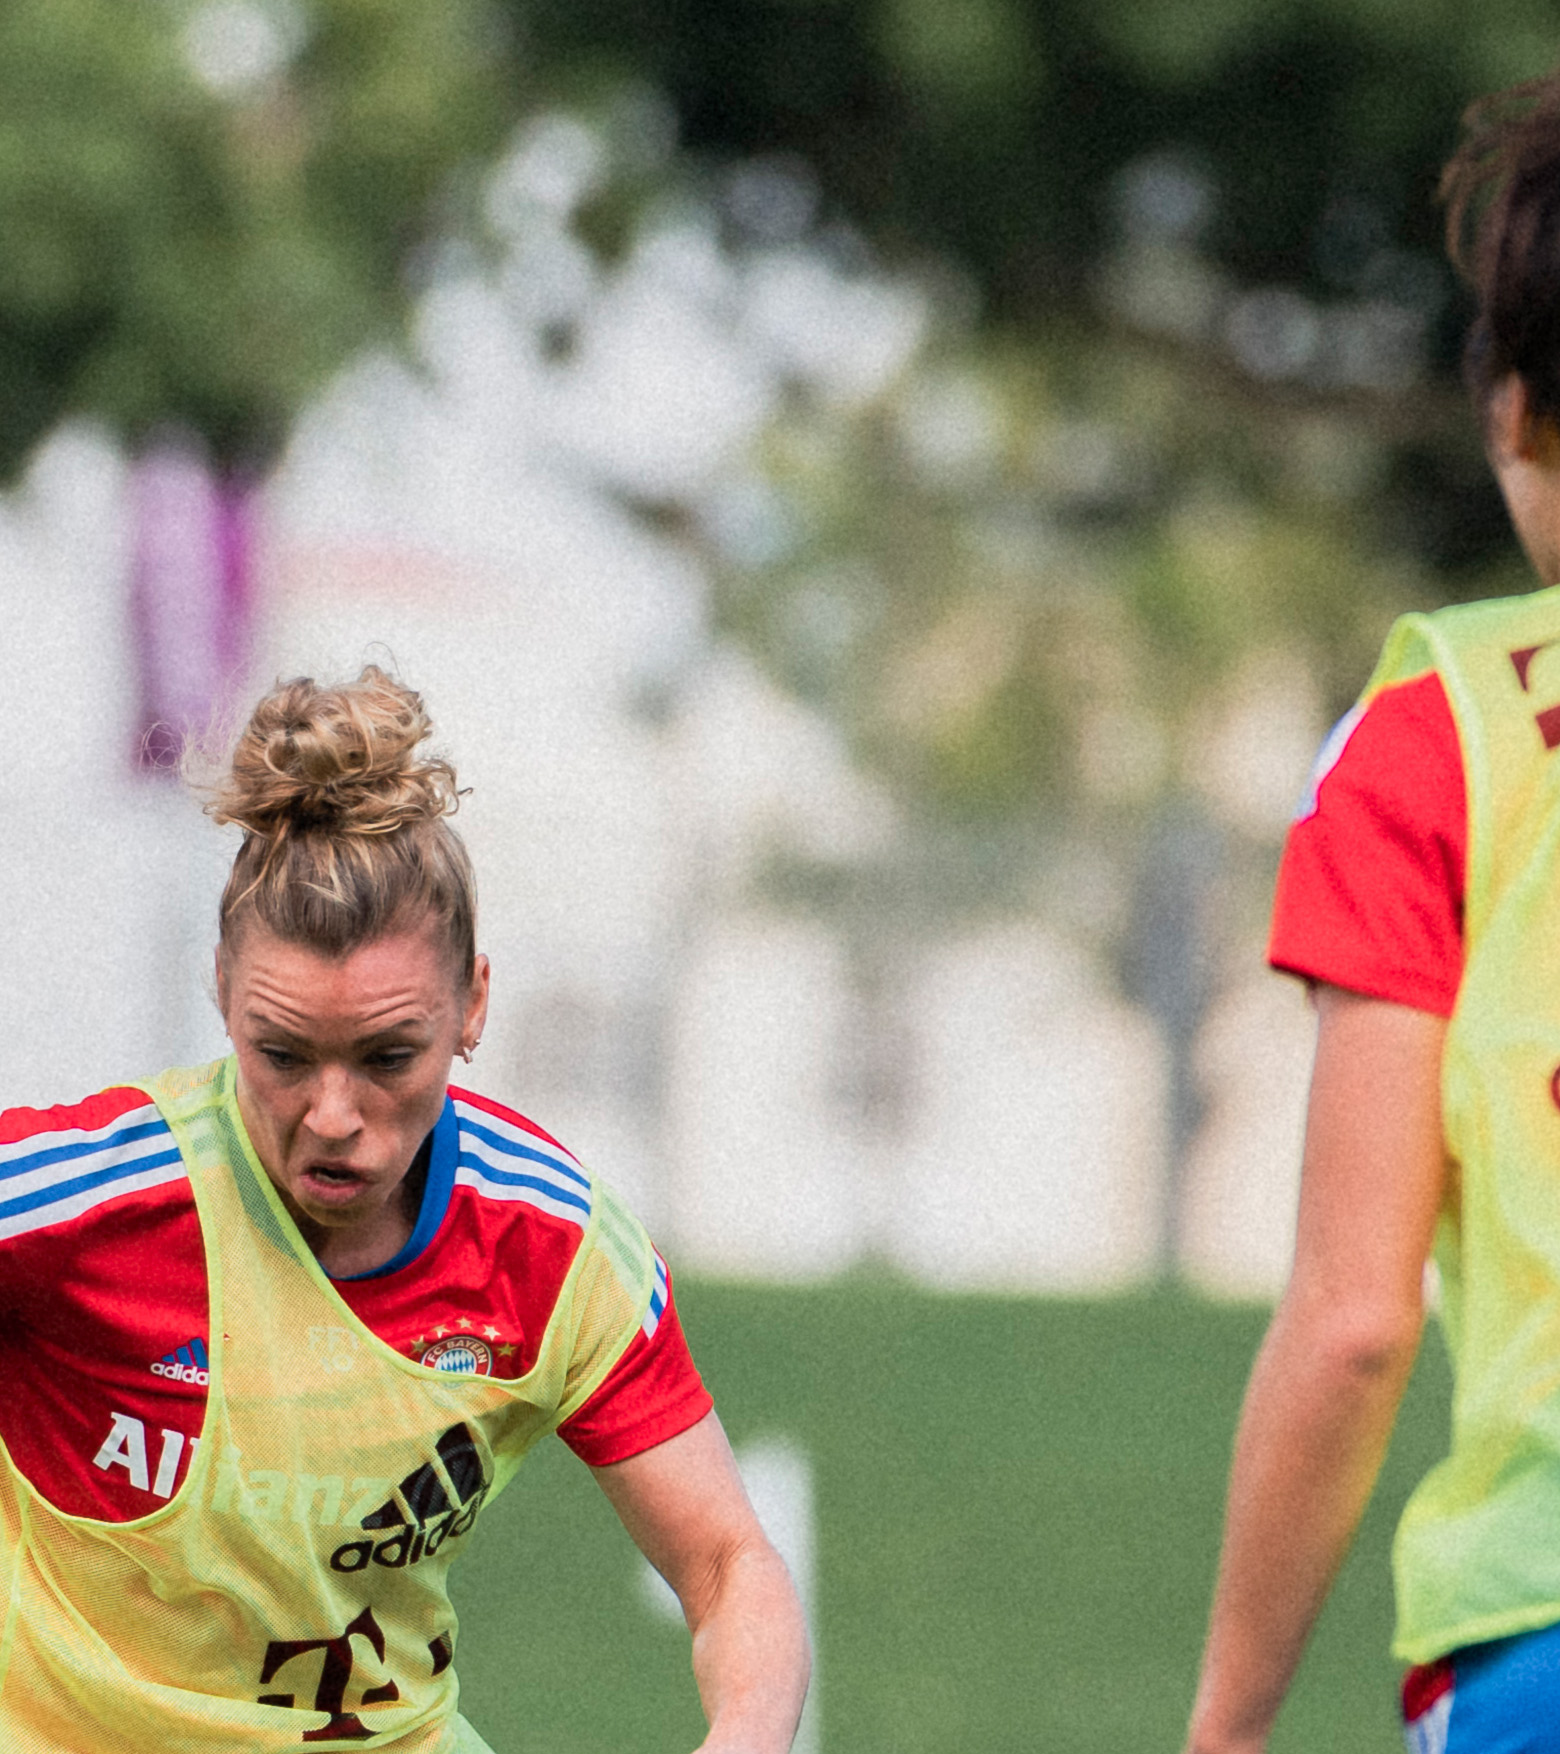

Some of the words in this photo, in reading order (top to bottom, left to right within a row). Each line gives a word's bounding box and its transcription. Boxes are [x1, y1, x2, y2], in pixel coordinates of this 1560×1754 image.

[426, 1345, 444, 1364] FC
[446, 1338, 489, 1365] BAYERN
[150, 1362, 210, 1386] adida
[330, 1480, 485, 1573] adida
